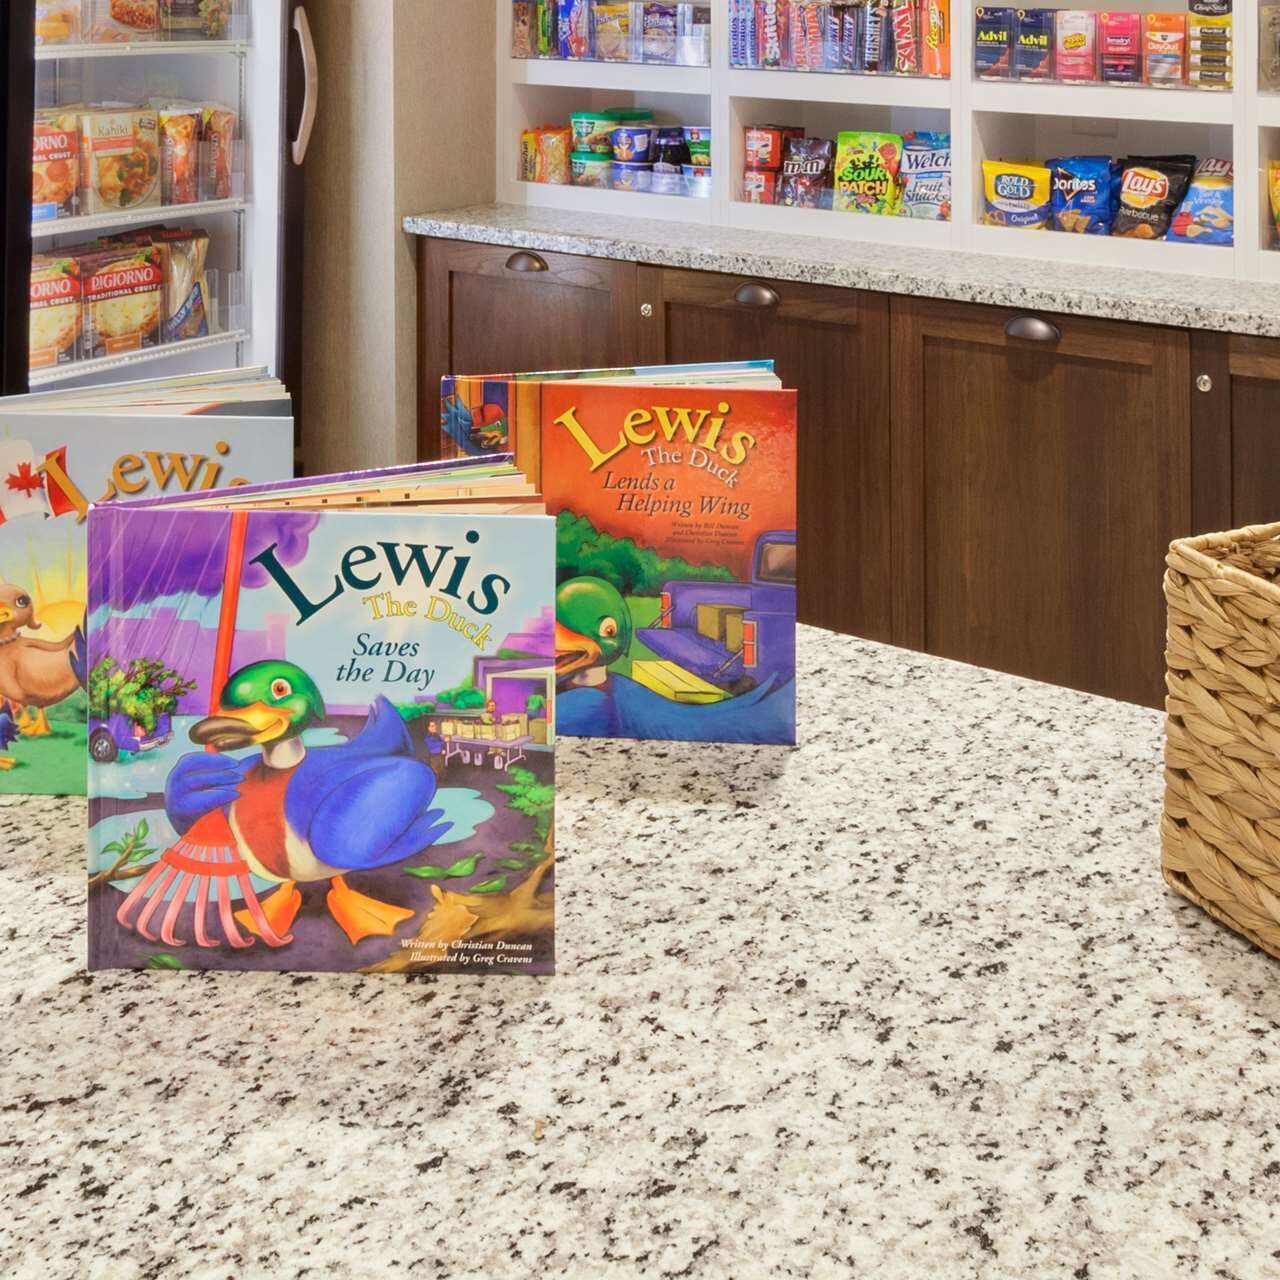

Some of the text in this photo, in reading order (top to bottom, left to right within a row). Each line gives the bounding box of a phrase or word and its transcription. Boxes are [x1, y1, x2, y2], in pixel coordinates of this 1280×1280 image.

[894, 0, 916, 70] TWIX
[977, 31, 1007, 42] Advil
[1018, 34, 1048, 46] Advil
[33, 134, 68, 152] ORNO
[907, 150, 952, 170] Welch
[841, 167, 888, 182] SOUR
[1001, 175, 1030, 186] ROLD
[1122, 171, 1167, 195] Lay's
[838, 180, 888, 195] PATCH
[912, 181, 944, 195] Fruit
[997, 184, 1030, 199] GOLD
[904, 191, 951, 208] Snacks
[1010, 213, 1040, 225] Original
[31, 278, 71, 297] ORNO
[91, 267, 154, 291] DIGIORNO
[87, 284, 158, 302] TRADITIONAL CRUST
[553, 401, 756, 472] Lewis
[641, 446, 738, 488] The Duck
[35, 440, 252, 524] Lewi
[603, 471, 675, 490] Lends a
[616, 494, 752, 521] Helping Wing
[249, 529, 511, 627] Lewis
[362, 591, 493, 651] The Duck
[352, 632, 420, 657] Saves
[335, 658, 436, 691] the Day
[401, 938, 533, 951] Written by Christian Duncan
[410, 951, 533, 966] Illustrated by Greg Cravens
